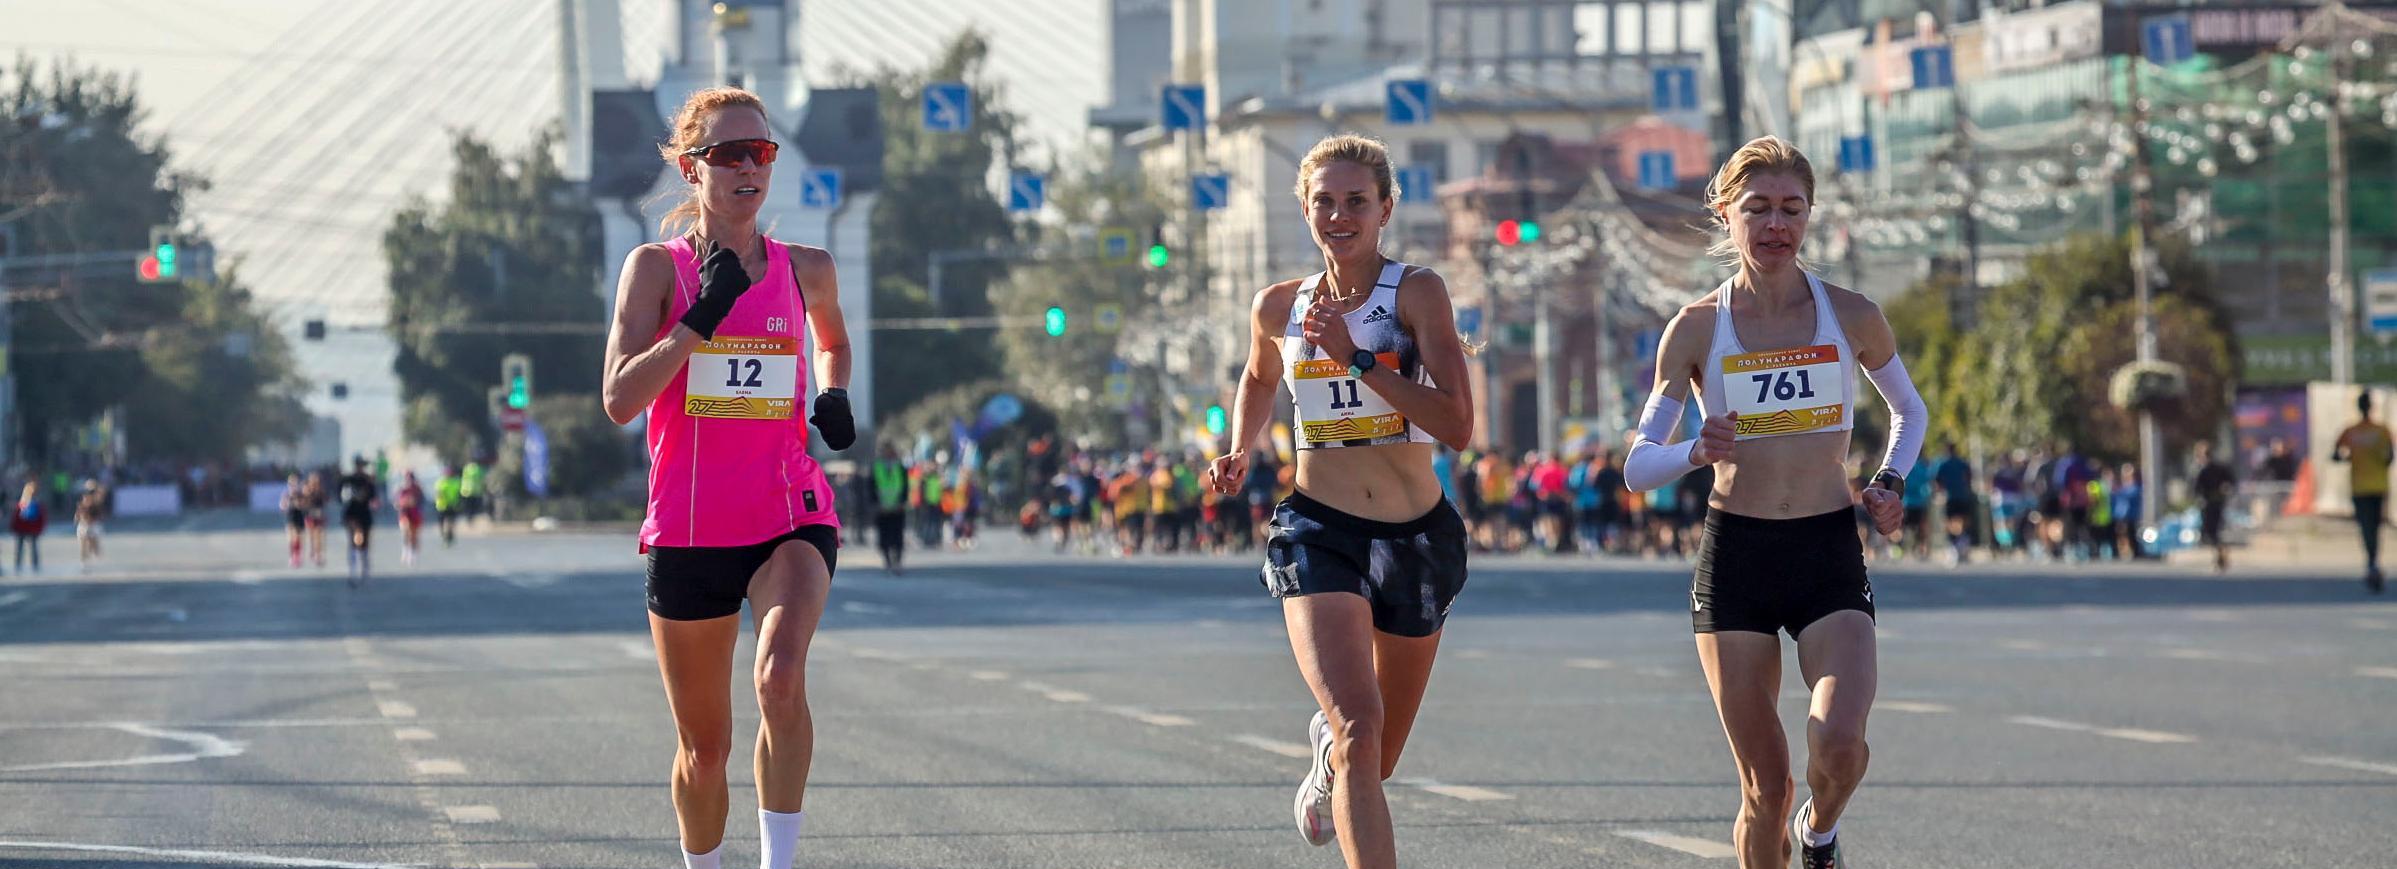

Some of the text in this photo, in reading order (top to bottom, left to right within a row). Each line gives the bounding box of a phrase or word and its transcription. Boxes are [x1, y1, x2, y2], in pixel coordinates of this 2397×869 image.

[1362, 313, 1393, 325] adidas
[1737, 353, 1817, 367] ПОЛУМАРАФОН
[726, 359, 762, 387] 12
[1327, 379, 1363, 410] 11
[1751, 369, 1815, 404] 761
[687, 398, 714, 416] 27
[1811, 407, 1837, 415] VIRA
[1372, 415, 1399, 424] VIRA
